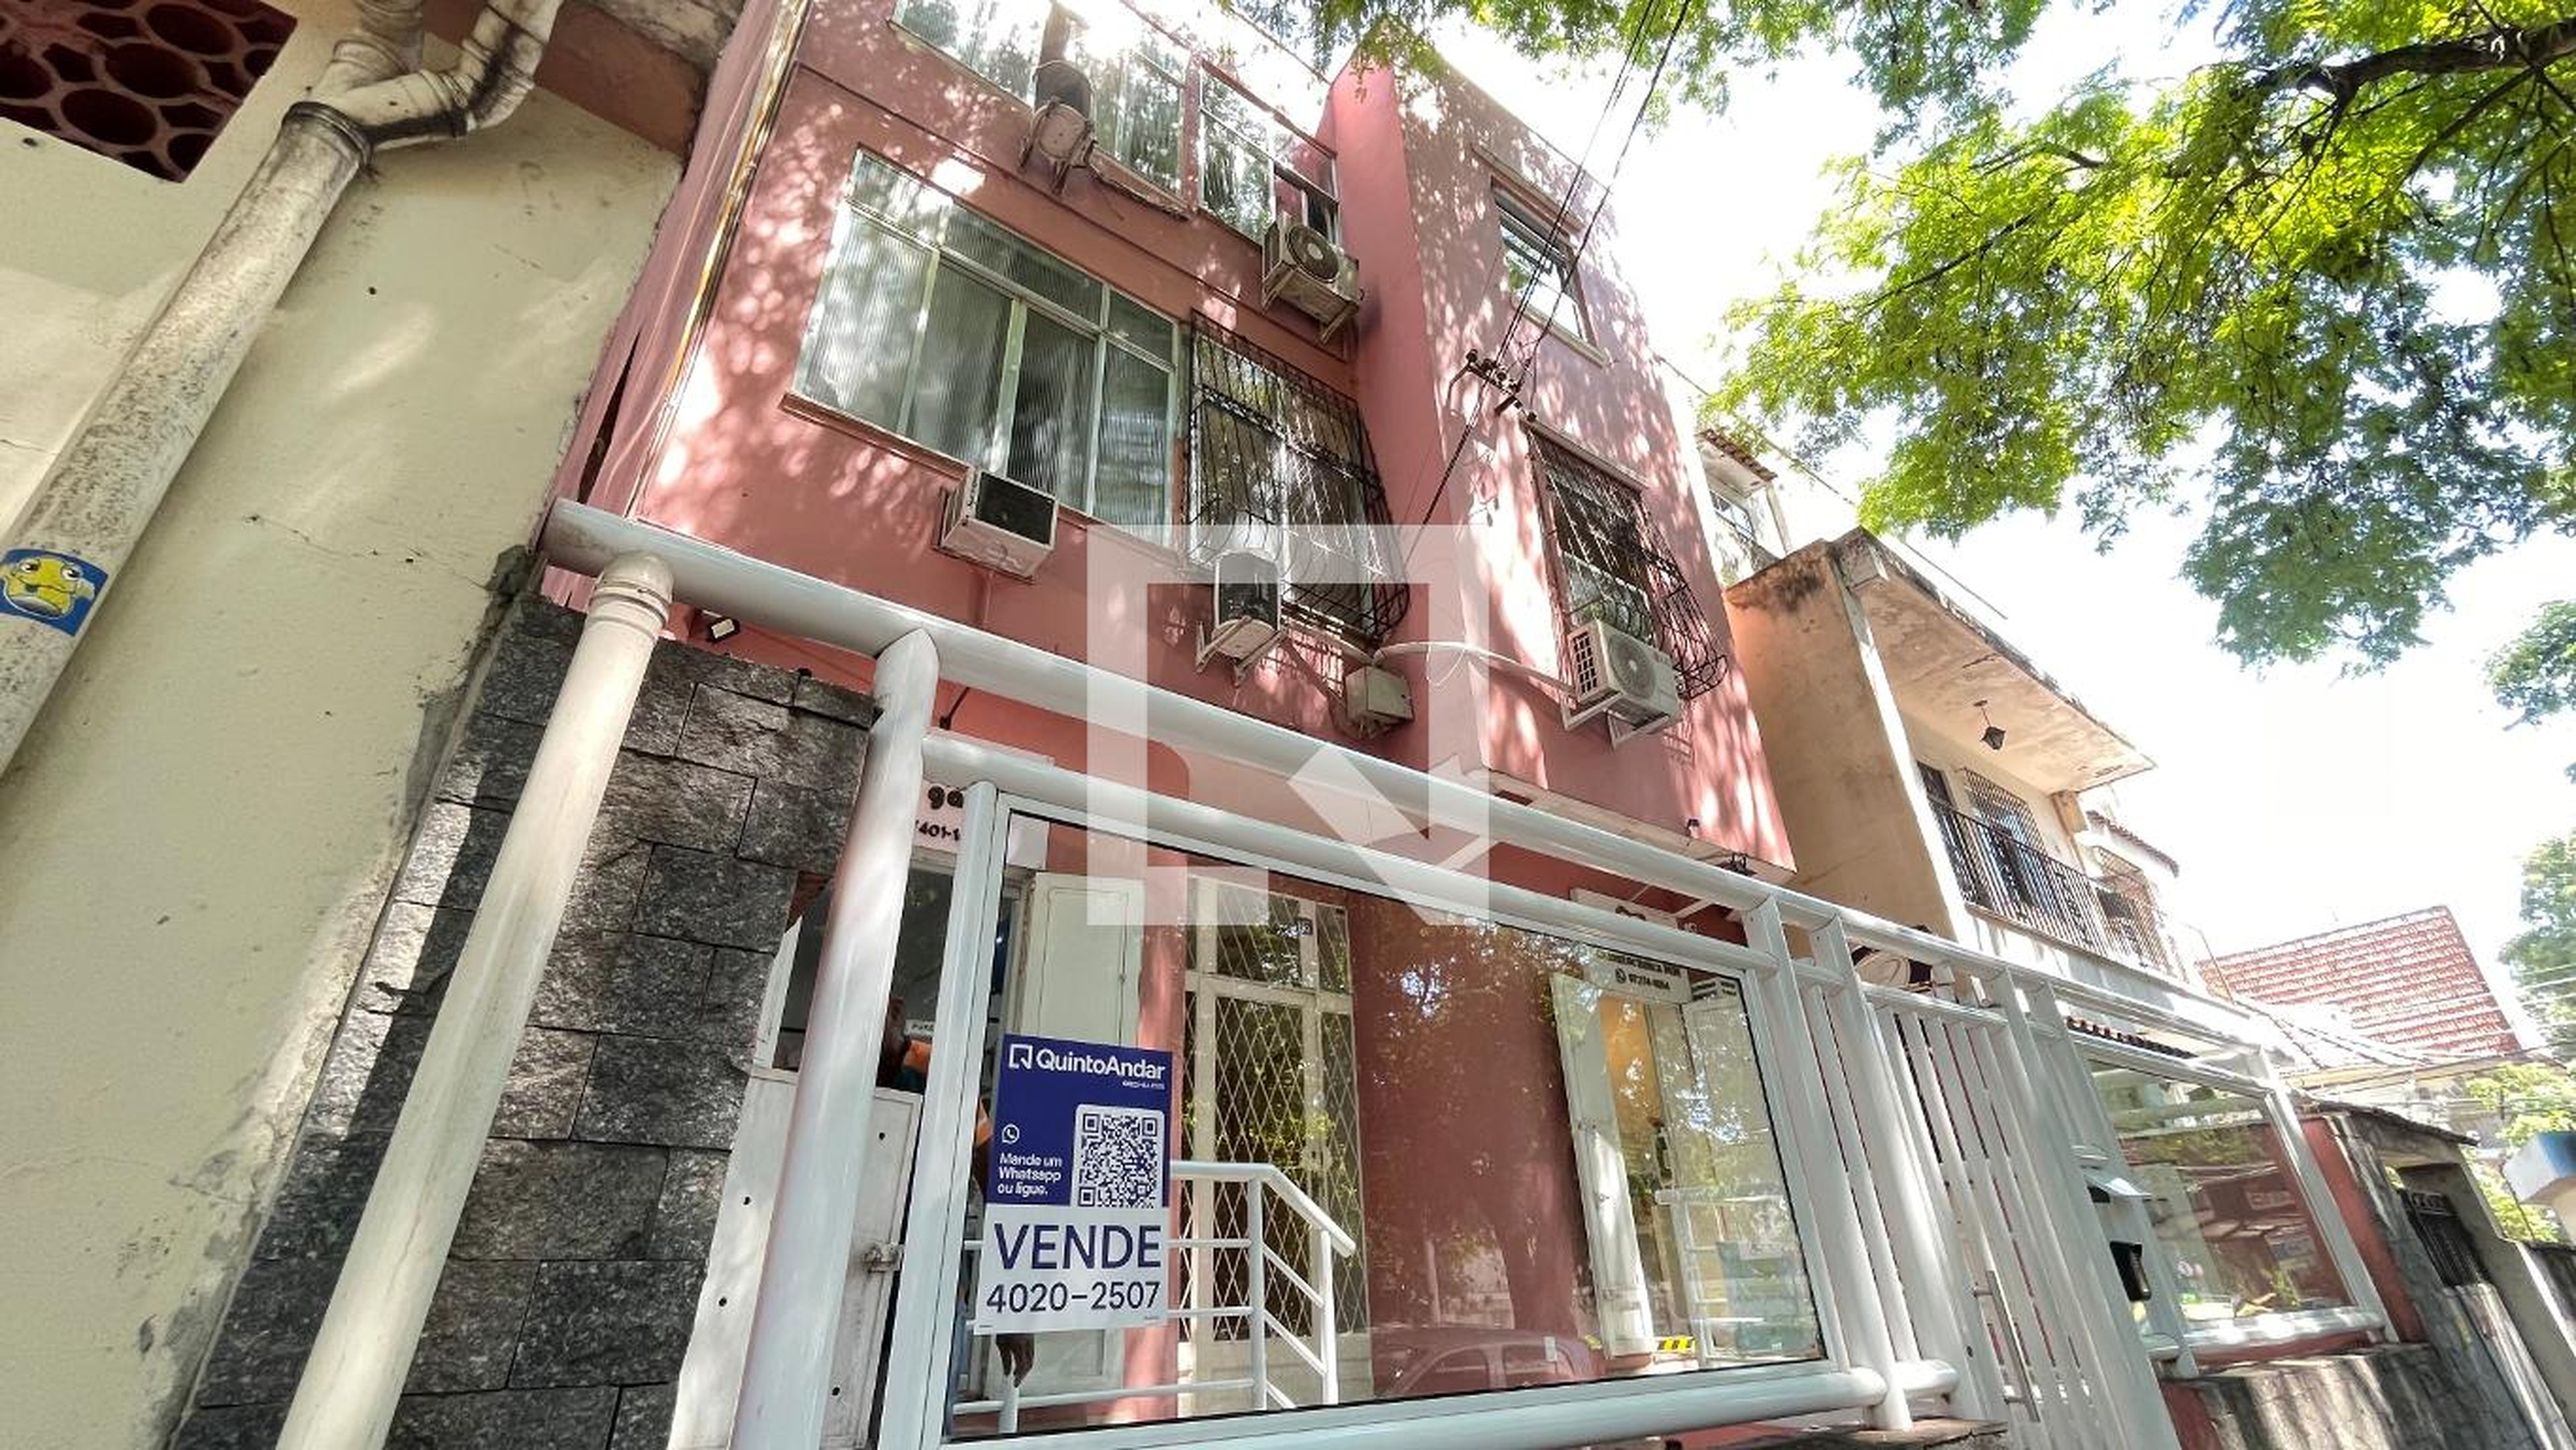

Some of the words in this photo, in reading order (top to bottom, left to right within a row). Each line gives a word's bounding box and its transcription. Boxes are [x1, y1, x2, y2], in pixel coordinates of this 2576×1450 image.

[1036, 1049, 1165, 1079] QuintoAndar
[1000, 1153, 1042, 1166] Mande
[1044, 1157, 1063, 1167] um
[998, 1184, 1014, 1194] ou
[994, 1223, 1162, 1270] VENDE
[987, 1282, 1160, 1313] 4020-2507
